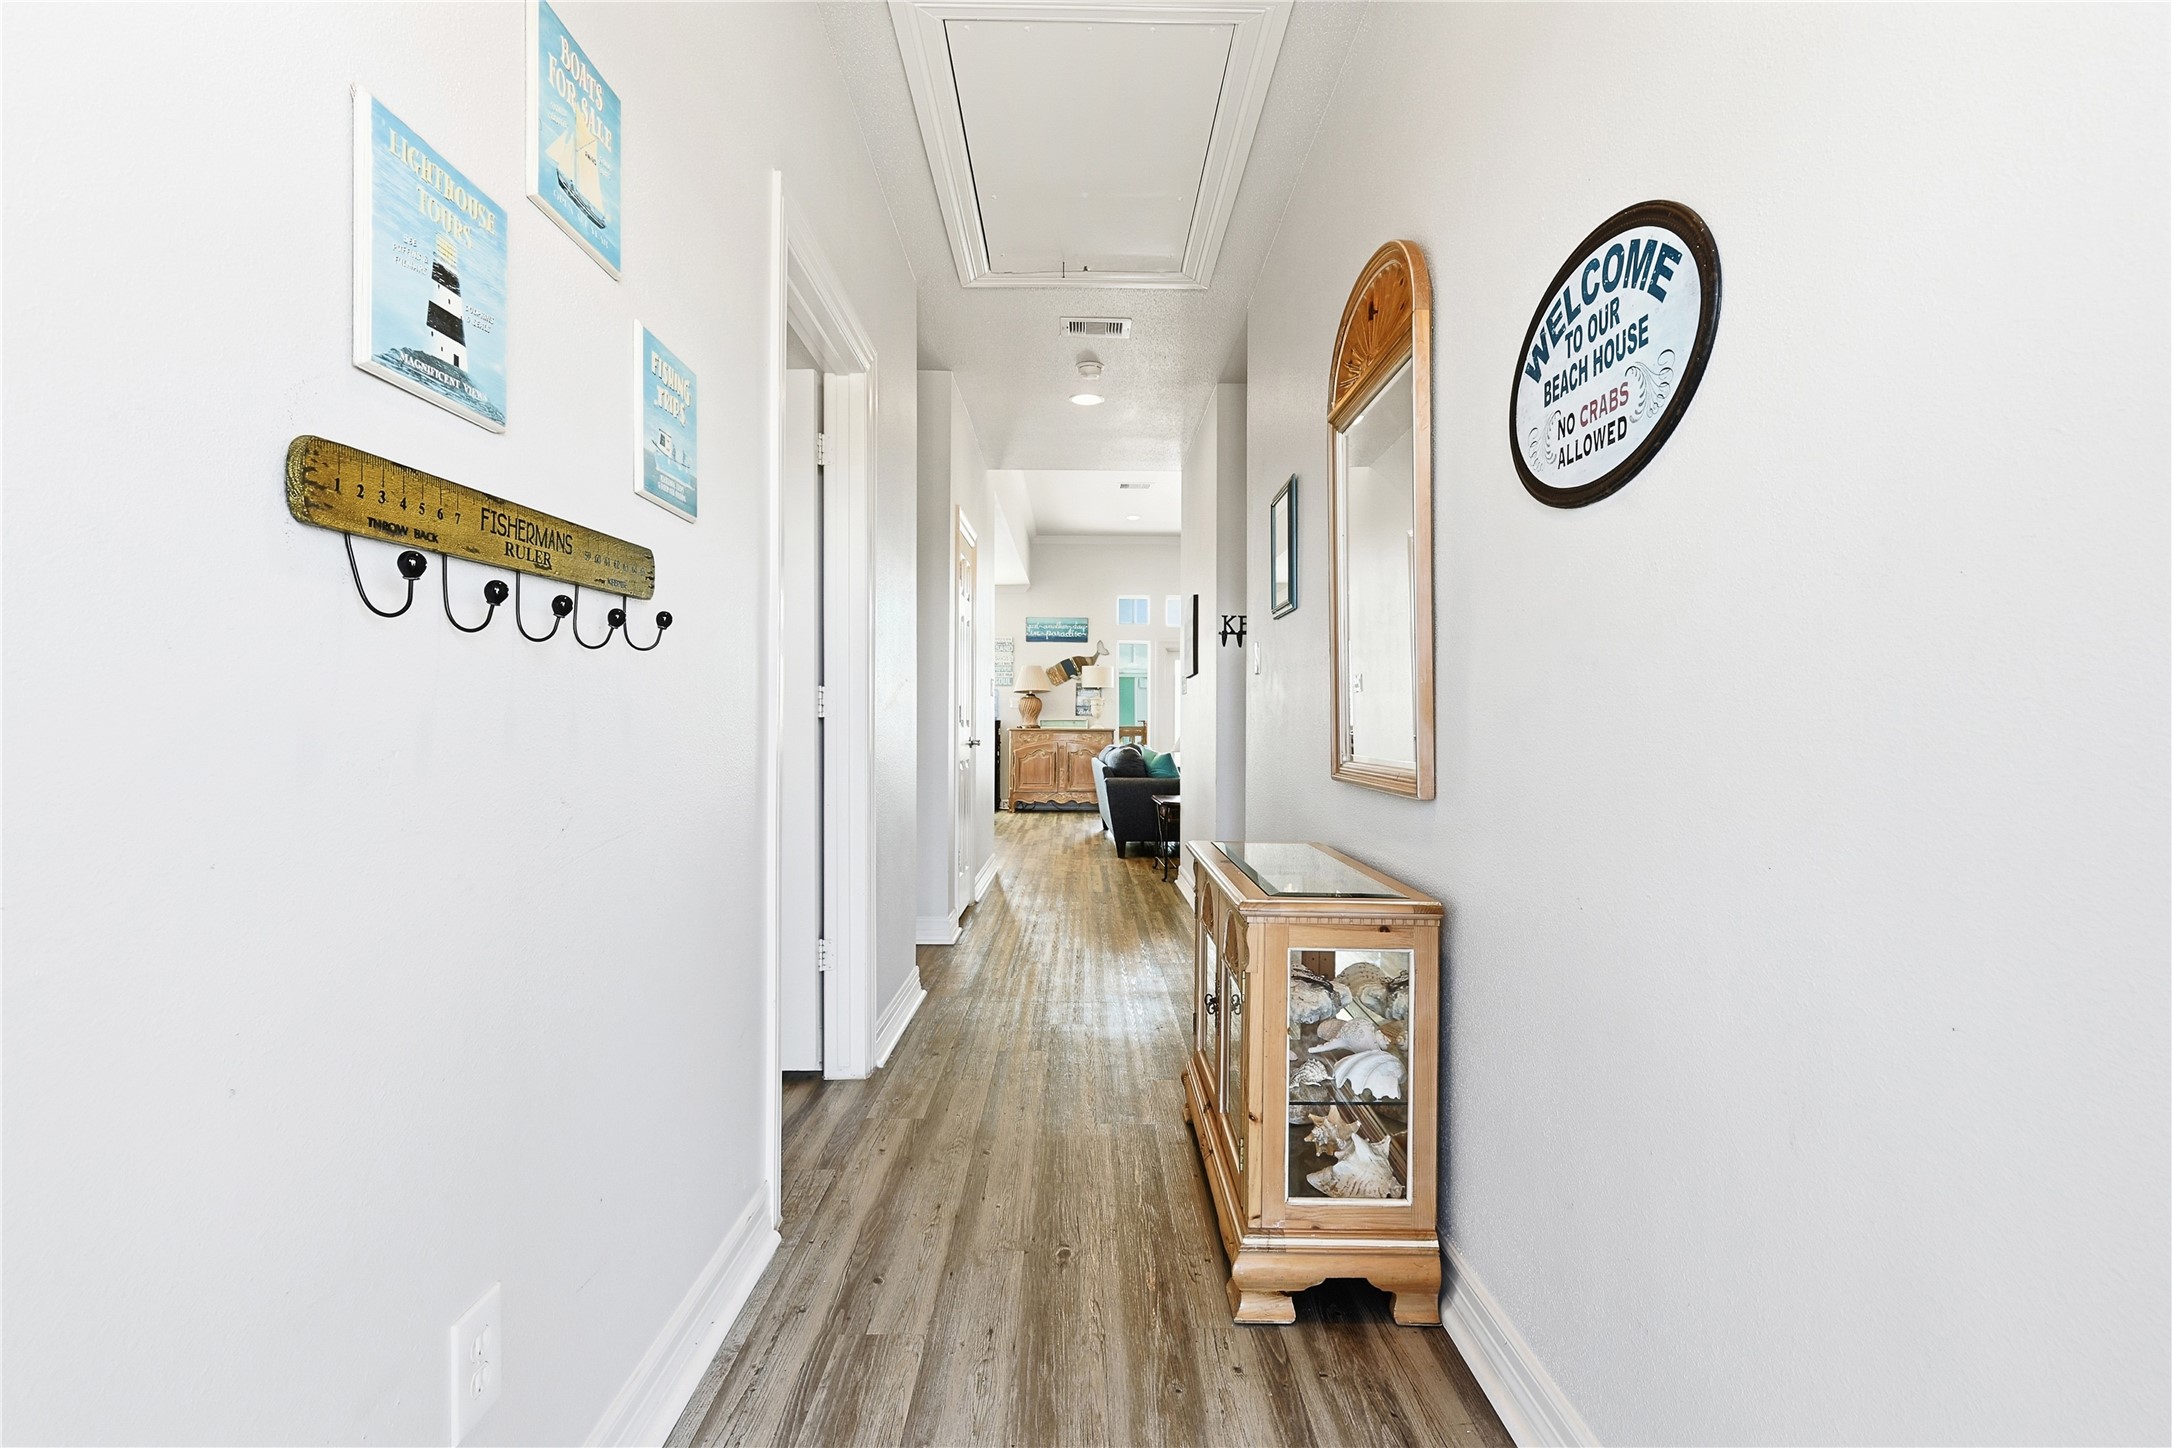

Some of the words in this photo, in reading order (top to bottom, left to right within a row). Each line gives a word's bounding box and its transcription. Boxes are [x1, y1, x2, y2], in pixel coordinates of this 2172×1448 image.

[548, 52, 576, 113] FOR
[581, 97, 612, 151] SALE
[560, 35, 603, 112] BOATS
[389, 128, 497, 236] LIGHTHOUSE
[417, 185, 473, 249] TOURS
[1525, 239, 1683, 383] WELCOME
[1565, 324, 1583, 358] TO
[1588, 296, 1620, 343] OUR
[399, 351, 460, 389] MAGNIFICENT
[651, 350, 691, 407] FISHING
[1544, 354, 1588, 408] BEACH
[1592, 314, 1649, 375] HOUSE
[654, 385, 686, 428] TRIPS
[1557, 414, 1576, 440] NO
[1580, 382, 1629, 428] CRABS
[1557, 416, 1627, 469] ALLOWED
[334, 478, 341, 492] 1
[356, 484, 364, 499] 2
[378, 490, 386, 504] 3
[400, 497, 407, 511] 4
[419, 502, 426, 515] 5
[437, 508, 443, 520] 6
[455, 513, 461, 524] 7
[367, 517, 408, 536] THROW
[414, 528, 439, 543] BACK
[481, 507, 573, 555] FISHERMANS
[504, 541, 551, 567] RULER
[1045, 628, 1084, 640] paradise
